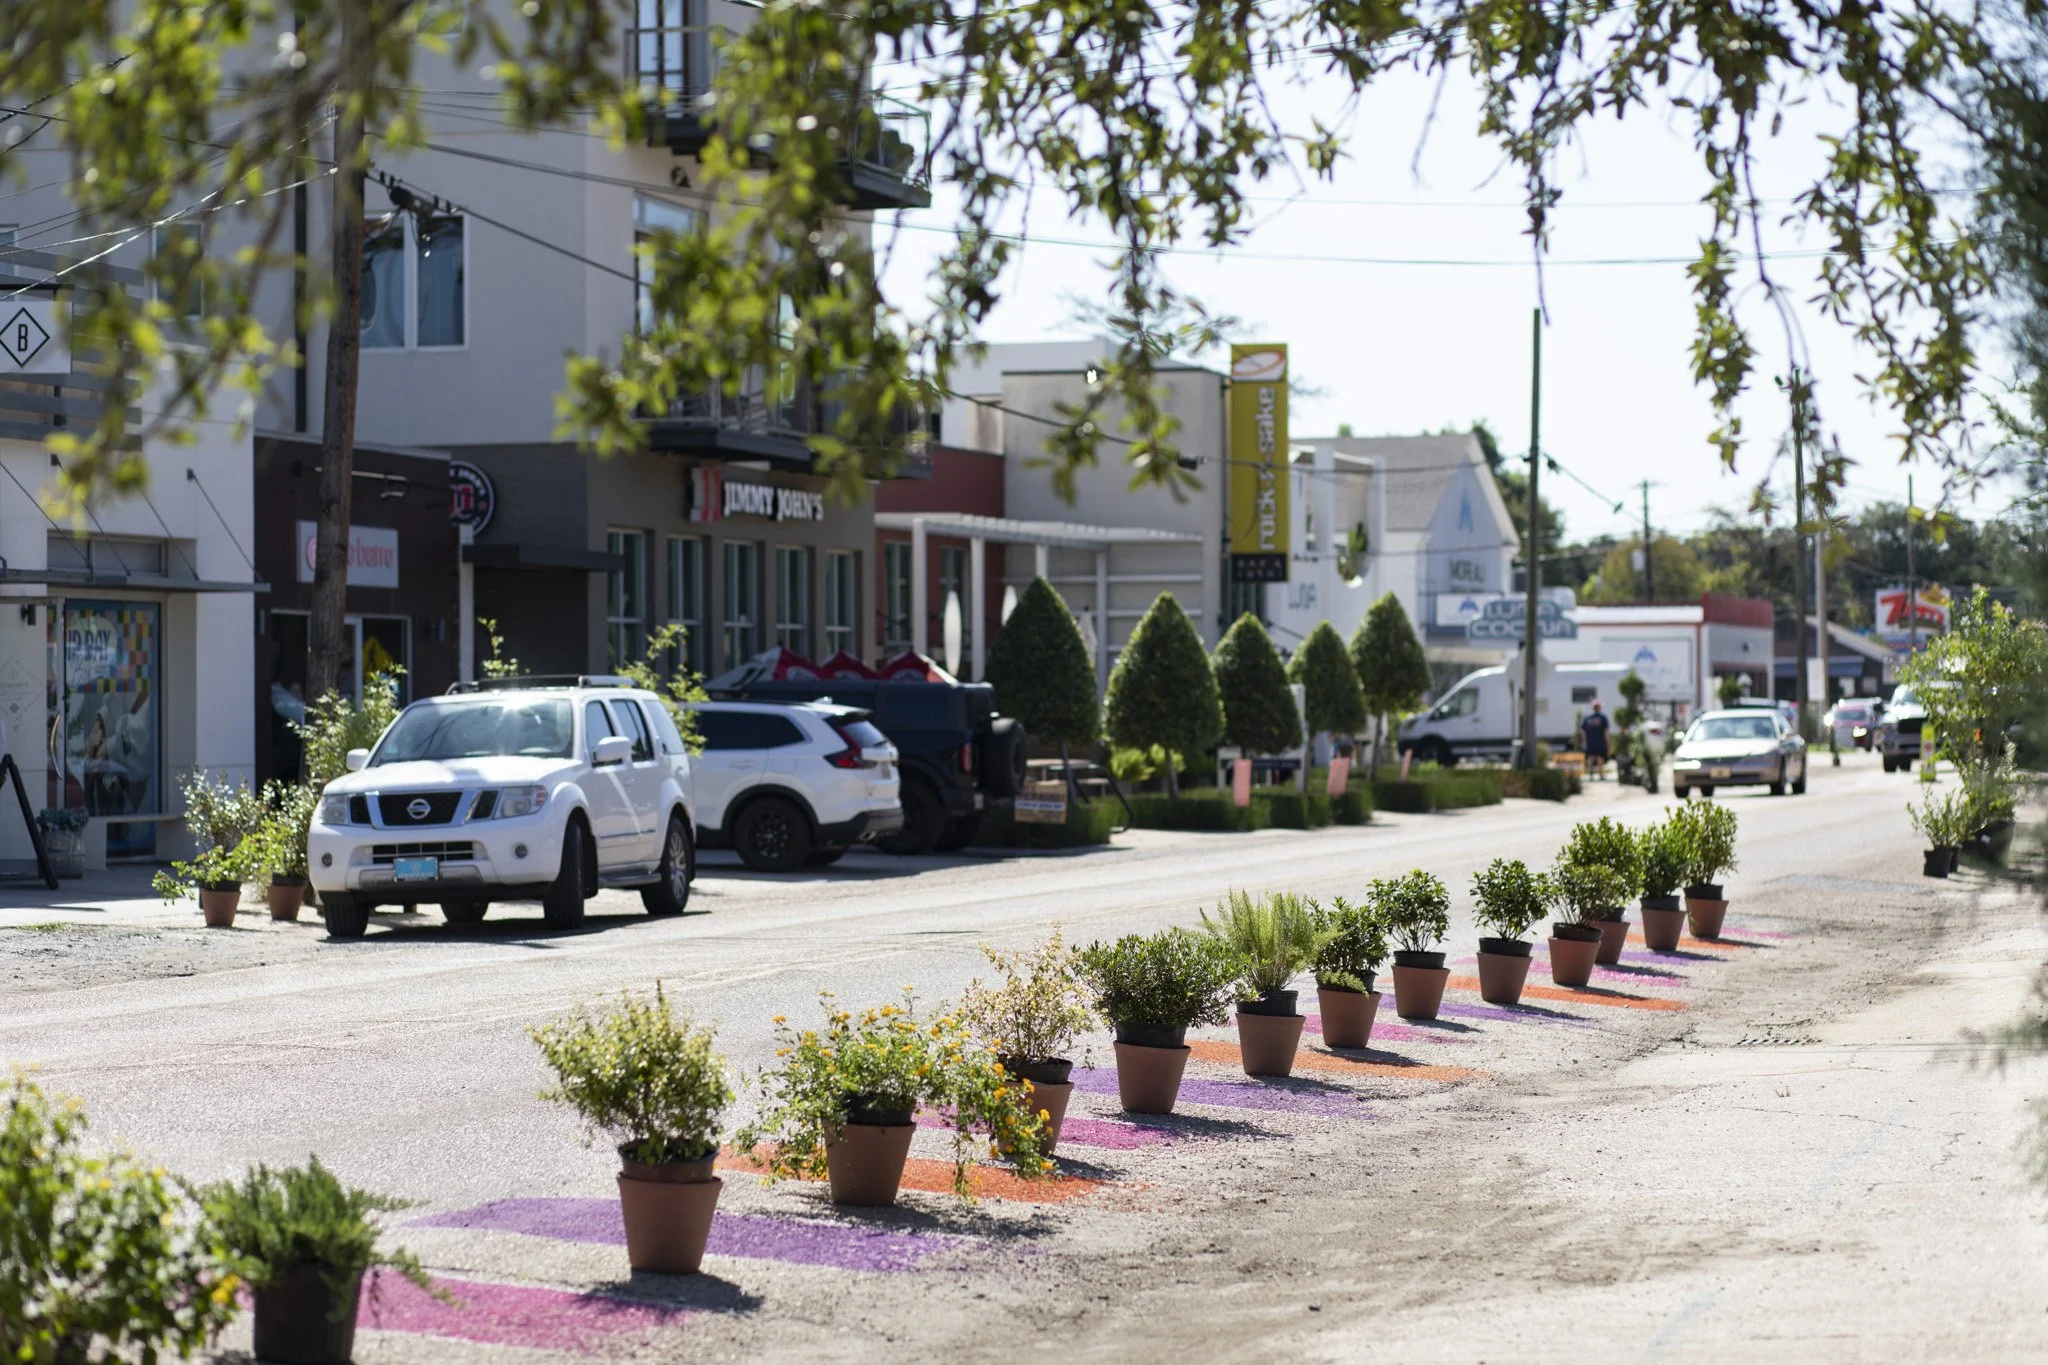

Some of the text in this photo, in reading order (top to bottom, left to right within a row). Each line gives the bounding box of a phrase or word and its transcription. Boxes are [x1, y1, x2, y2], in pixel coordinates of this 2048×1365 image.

[17, 323, 28, 352] B
[723, 481, 824, 522] JIMMY JOHN'S
[1471, 619, 1572, 637] COCNA
